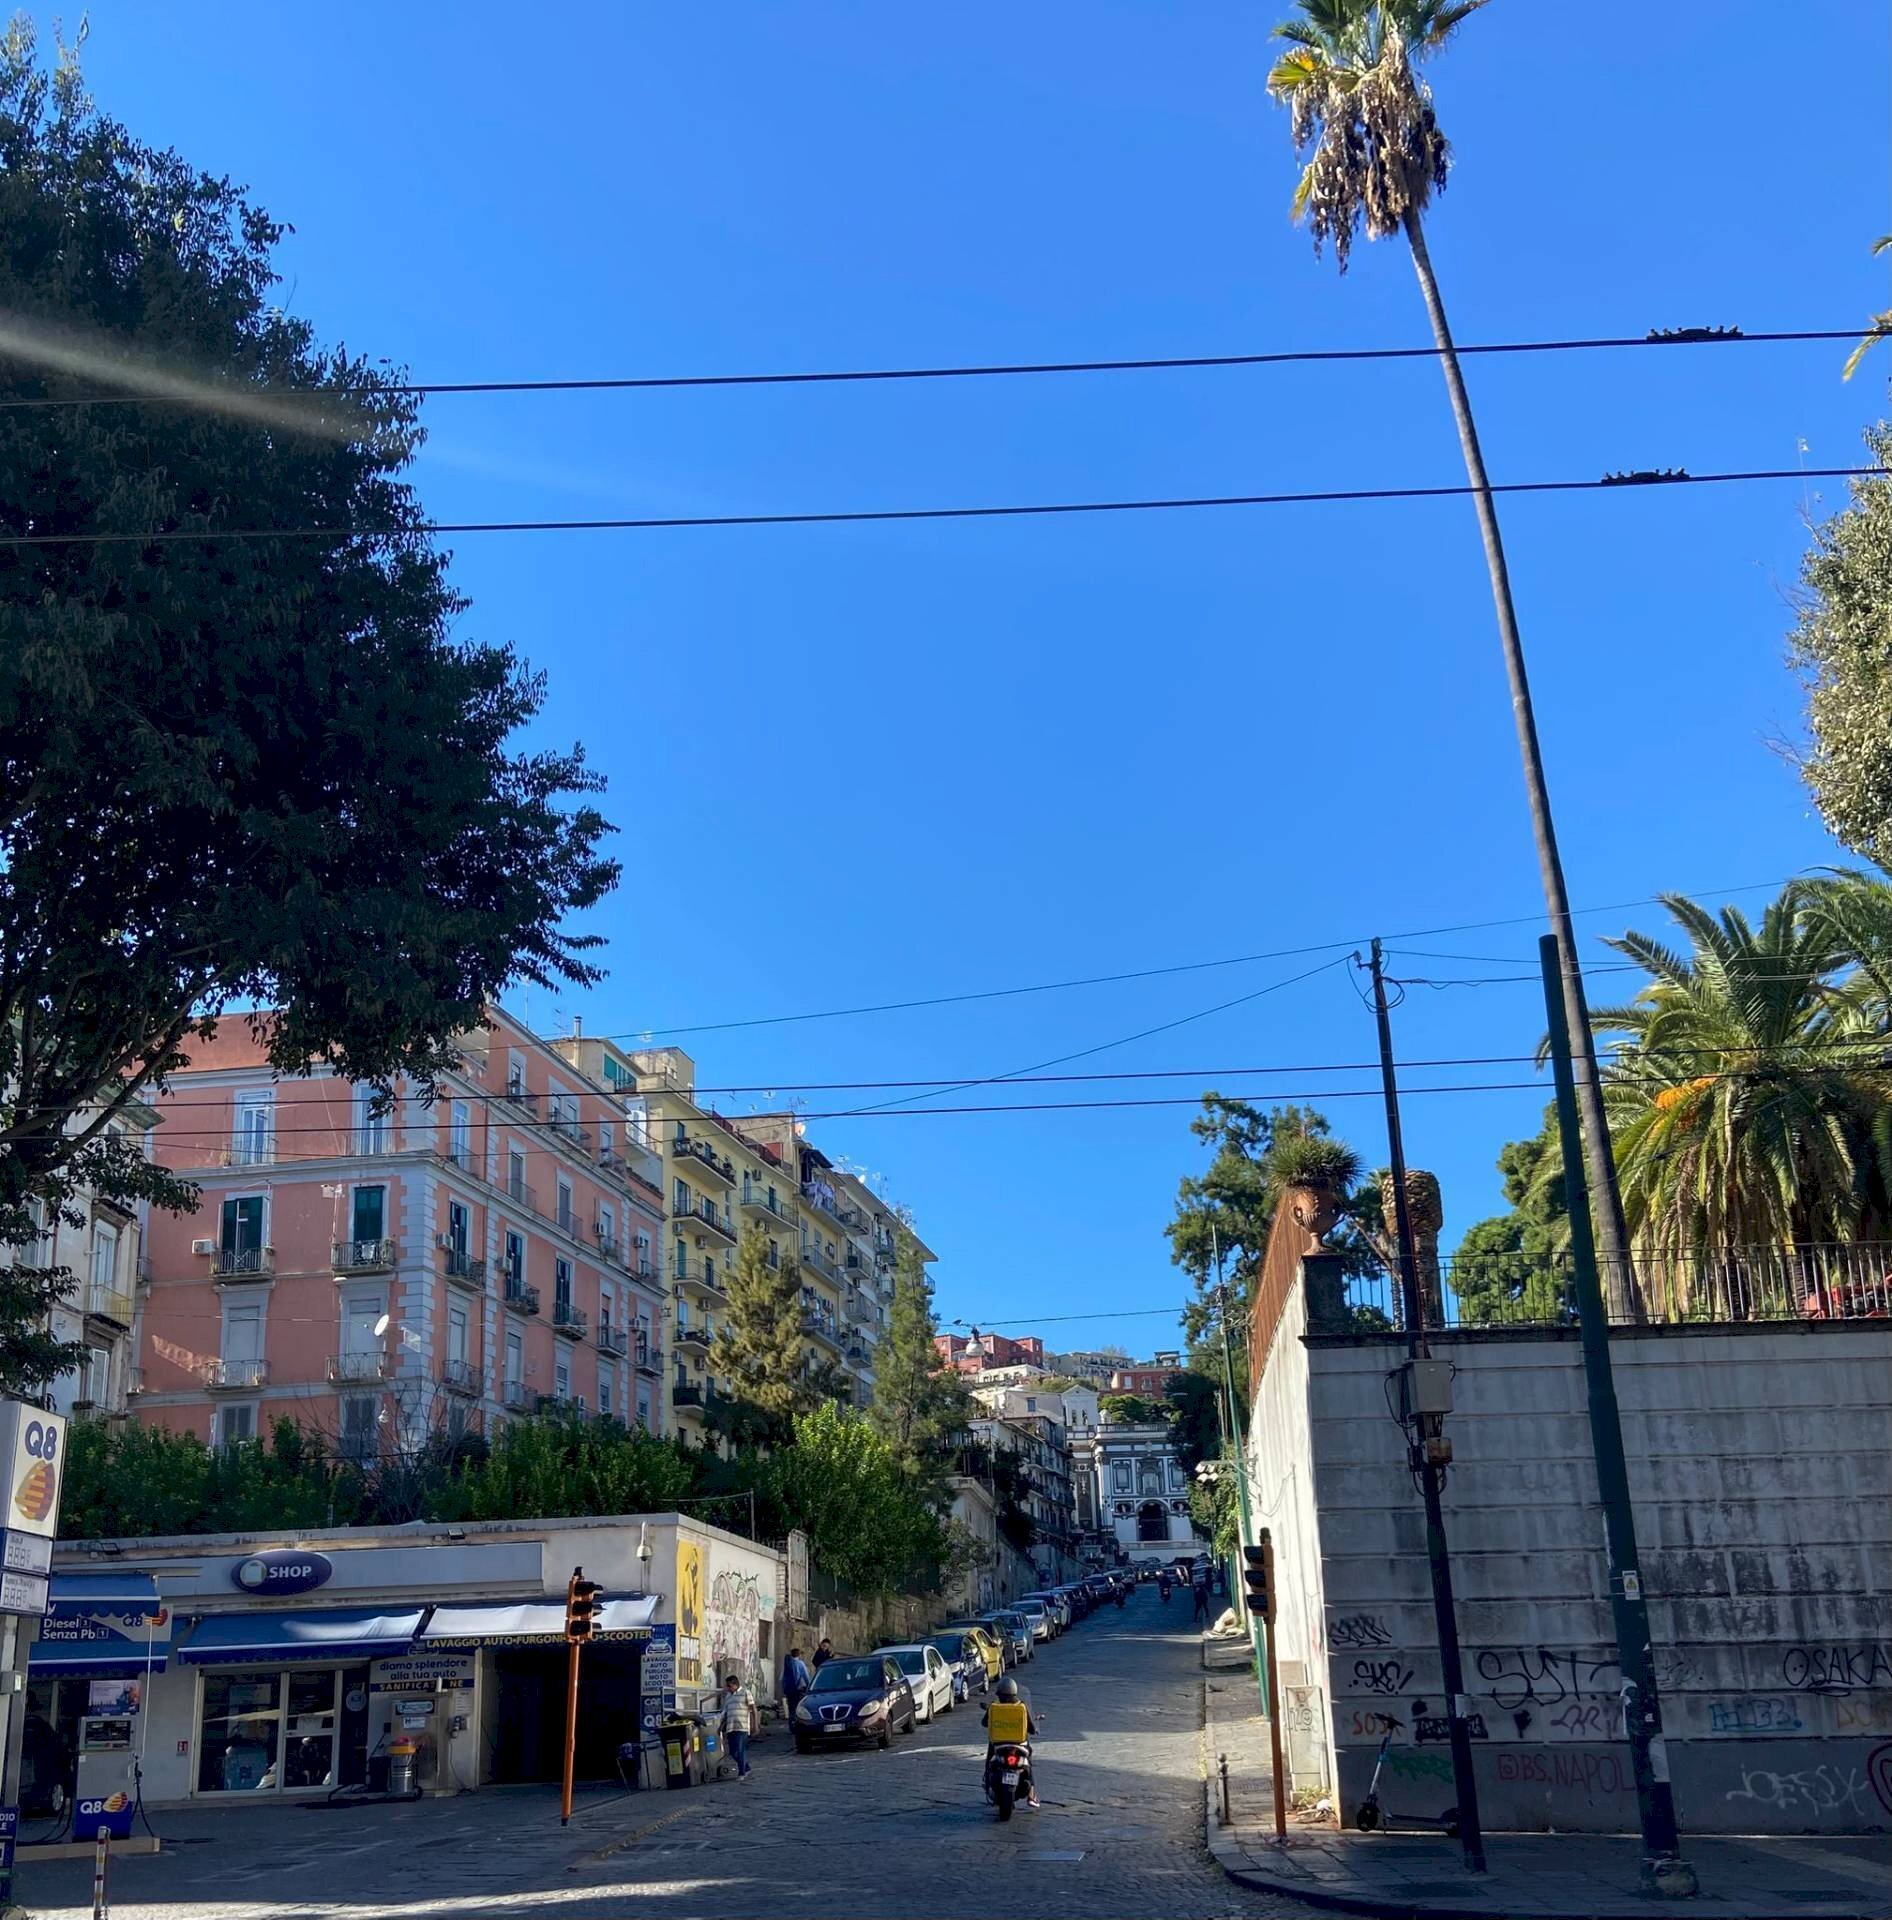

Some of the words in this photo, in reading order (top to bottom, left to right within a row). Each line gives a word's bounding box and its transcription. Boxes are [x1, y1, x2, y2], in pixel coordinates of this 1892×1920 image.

[24, 1420, 57, 1461] Q8
[269, 1565, 312, 1578] SHOP
[43, 1617, 79, 1629] Diesel
[122, 1615, 144, 1628] Q8
[42, 1628, 78, 1640] Senza
[80, 1628, 96, 1640] Pb
[426, 1638, 481, 1649] LAVAGGIO
[379, 1661, 412, 1671] diamo
[415, 1658, 468, 1672] splendore
[413, 1671, 430, 1679] tua
[432, 1669, 457, 1679] auto
[379, 1679, 464, 1692] SANIFICANE
[80, 1800, 103, 1814] Q8
